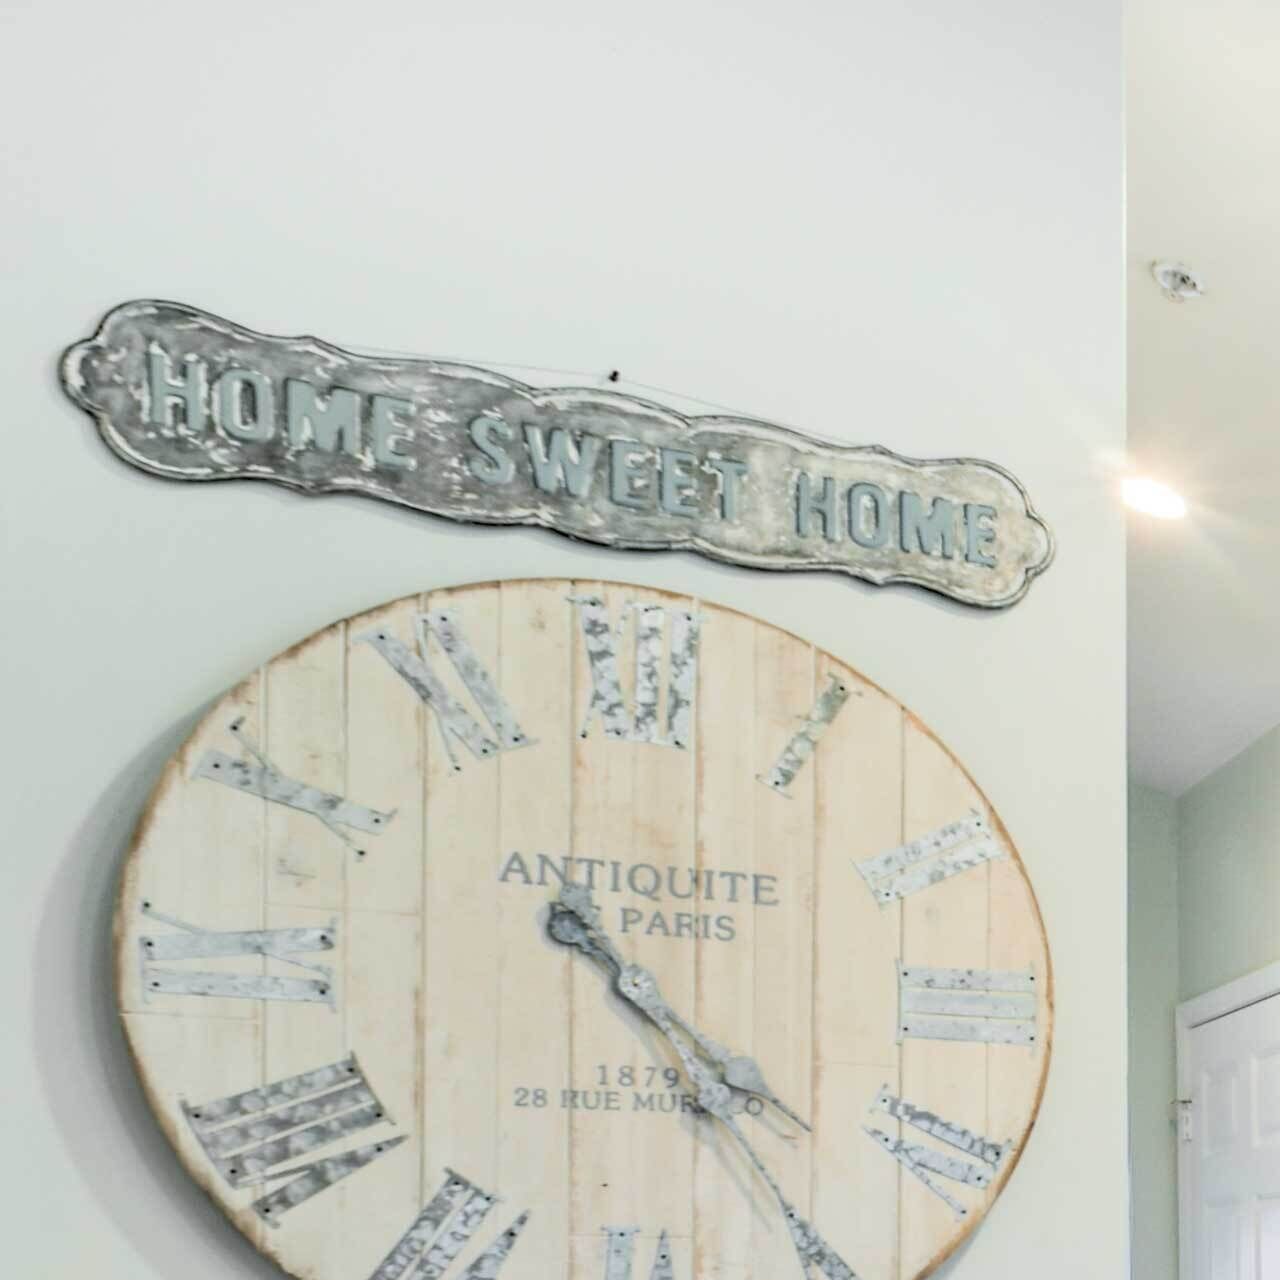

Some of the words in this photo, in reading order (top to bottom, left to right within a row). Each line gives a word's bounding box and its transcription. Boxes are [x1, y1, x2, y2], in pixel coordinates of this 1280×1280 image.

[145, 342, 417, 470] HOME
[468, 413, 749, 521] SWEET
[794, 470, 1000, 568] HOME
[567, 593, 705, 750] XII
[190, 714, 398, 861] X
[497, 850, 781, 907] ANTIQUITE
[853, 808, 1004, 909] II
[138, 897, 338, 1014] IX
[619, 906, 738, 943] PARIS
[895, 957, 1038, 1045] III
[513, 1086, 549, 1109] 28
[559, 1088, 622, 1112] RUE
[631, 1091, 765, 1116] MURO
[595, 1064, 681, 1089] 1879
